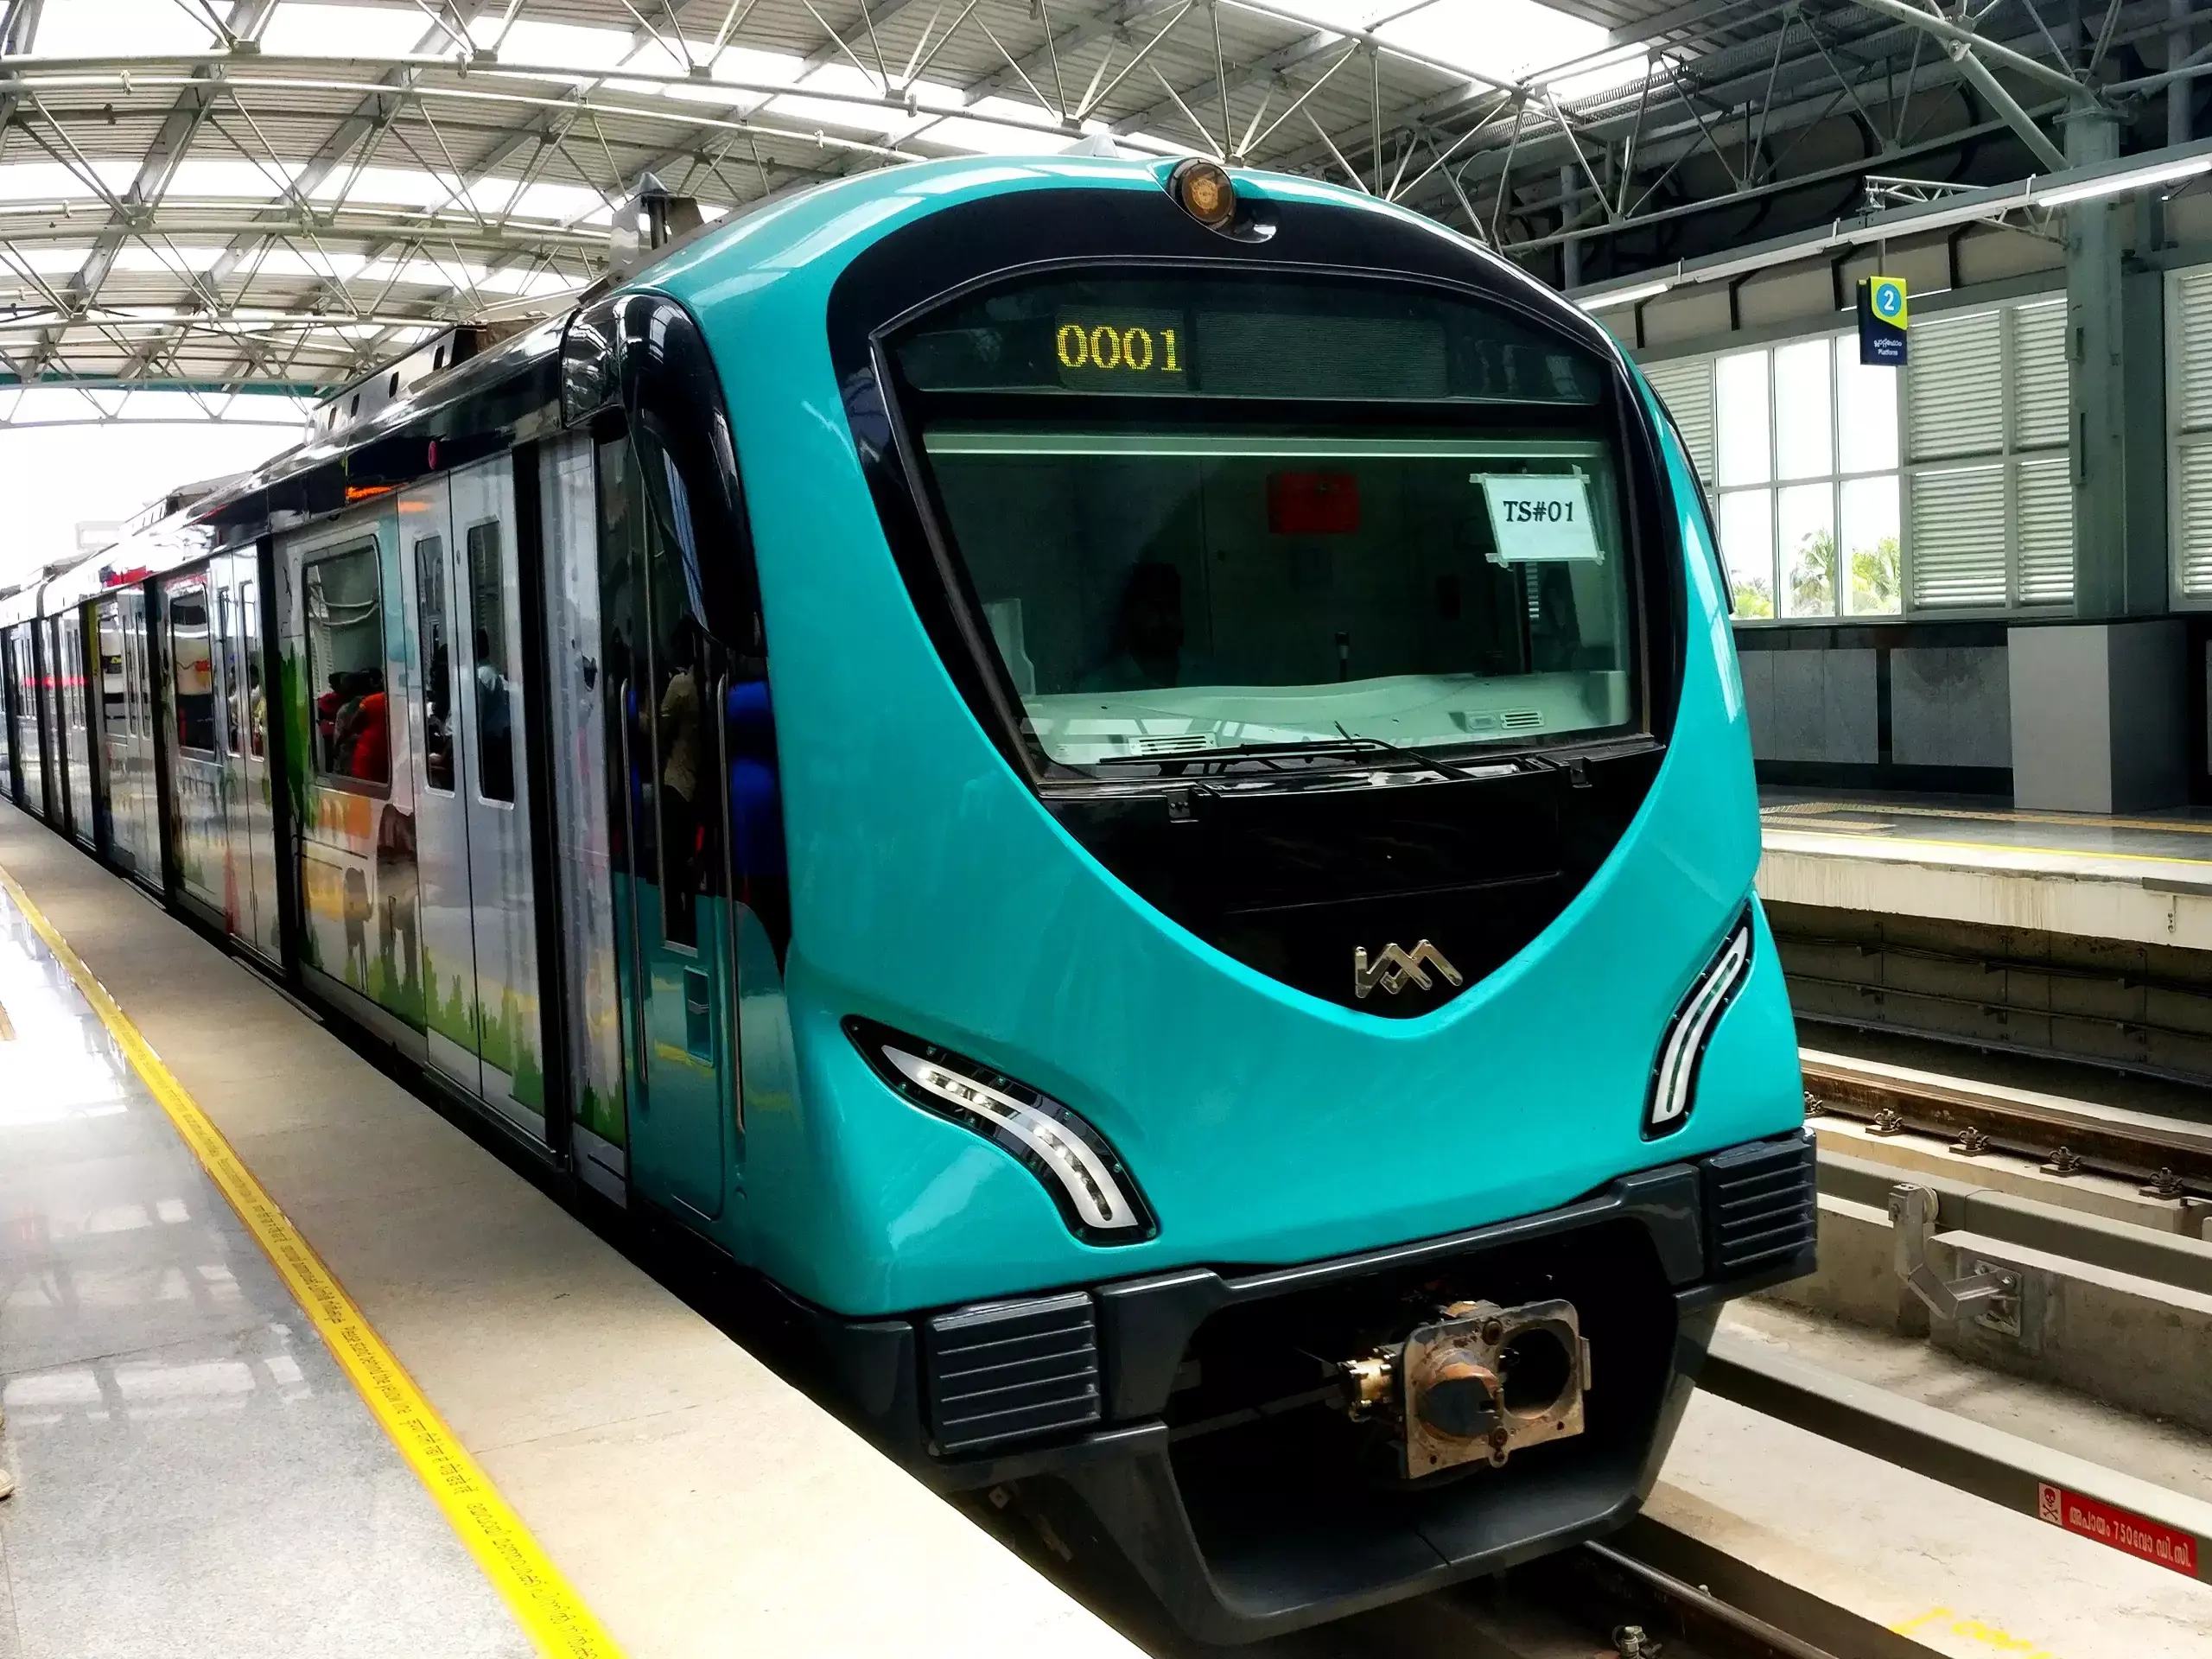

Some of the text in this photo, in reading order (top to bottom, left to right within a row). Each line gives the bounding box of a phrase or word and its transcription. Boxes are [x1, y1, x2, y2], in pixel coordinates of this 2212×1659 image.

[1884, 289, 1895, 310] 2
[1057, 325, 1182, 372] 0001
[1503, 500, 1574, 523] TS#01
[2069, 1506, 2111, 1537] അപായം
